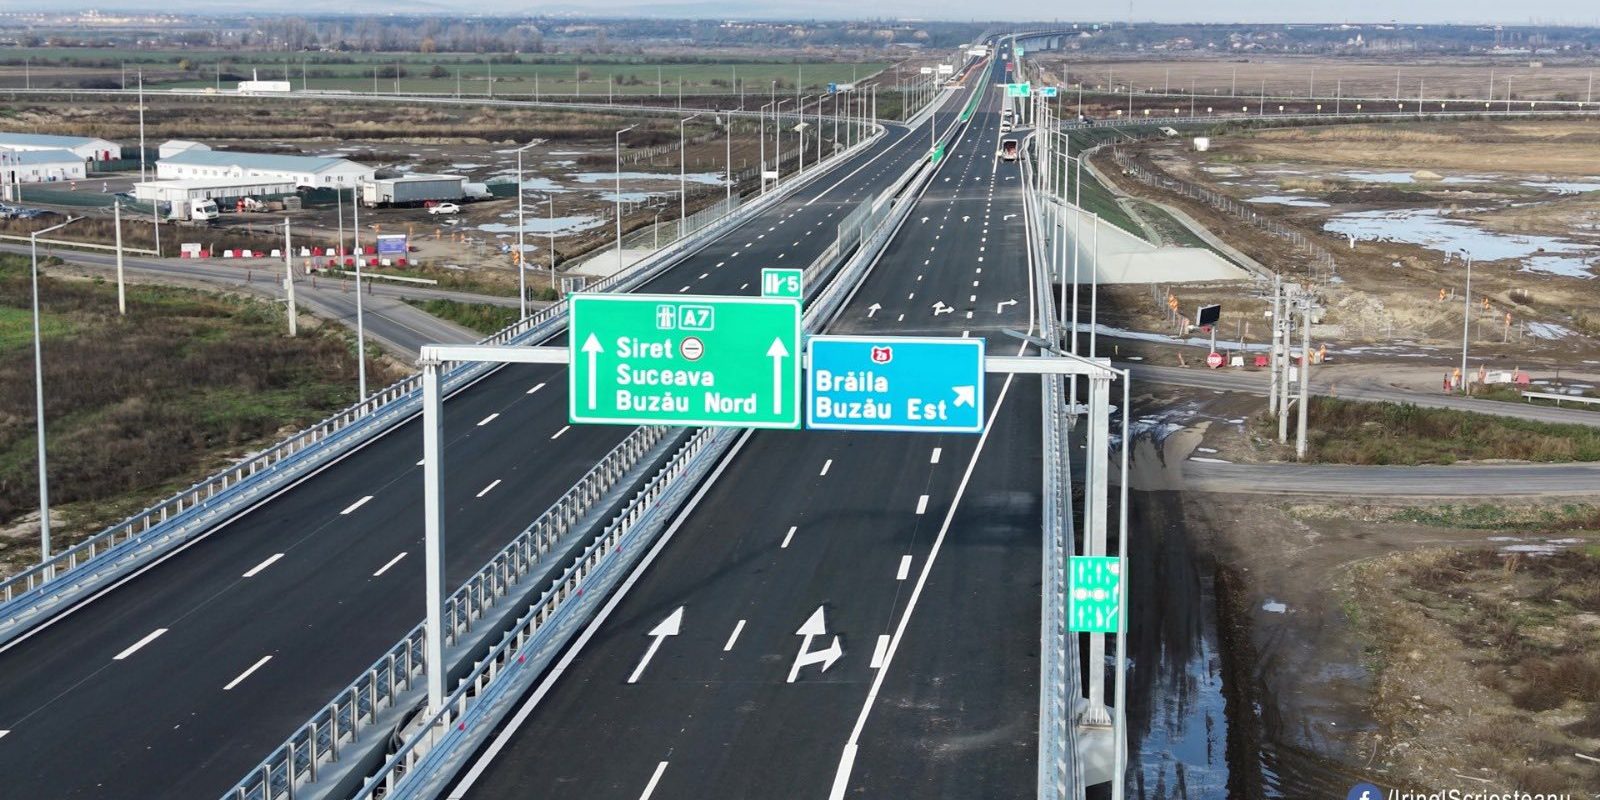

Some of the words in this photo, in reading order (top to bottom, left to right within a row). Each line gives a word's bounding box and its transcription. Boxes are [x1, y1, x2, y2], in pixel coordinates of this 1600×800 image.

[787, 275, 799, 291] 5
[683, 310, 710, 326] A7
[616, 336, 673, 359] Siret
[616, 363, 715, 387] Suceava
[816, 369, 889, 393] Brăila
[616, 389, 689, 412] Buzău
[704, 391, 757, 414] Nord
[816, 396, 892, 419] Buzău
[907, 398, 948, 420] Est
